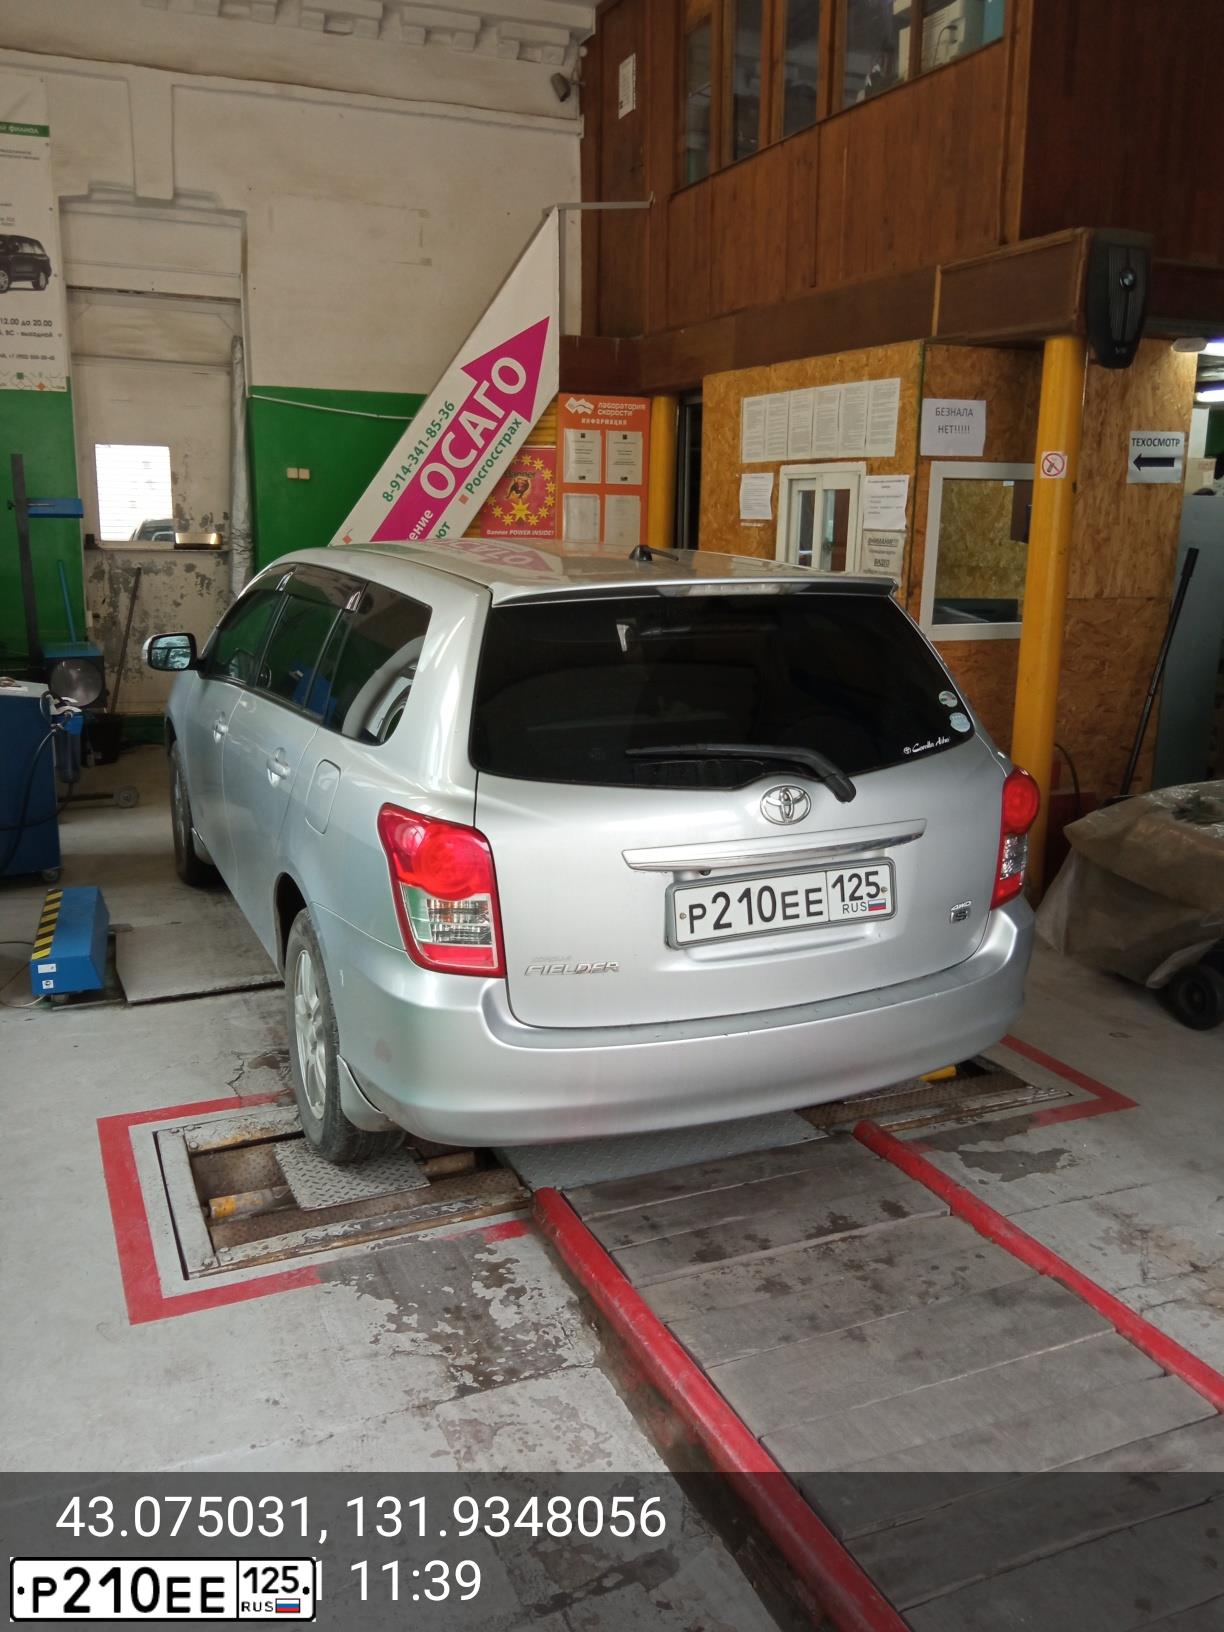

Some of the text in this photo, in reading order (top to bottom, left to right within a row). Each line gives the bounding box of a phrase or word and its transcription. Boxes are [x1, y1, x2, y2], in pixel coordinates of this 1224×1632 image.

[420, 357, 527, 499] ОСАГО
[935, 407, 974, 417] БЕЗНАЛА
[382, 400, 455, 502] 8-914-341-85-36
[465, 416, 523, 495] Росгосстрах
[1131, 437, 1181, 448] ТЕХОСМОТР
[687, 870, 881, 934] Р210ЕЕ 125
[842, 901, 867, 915] RUS
[524, 961, 620, 976] FIELDER
